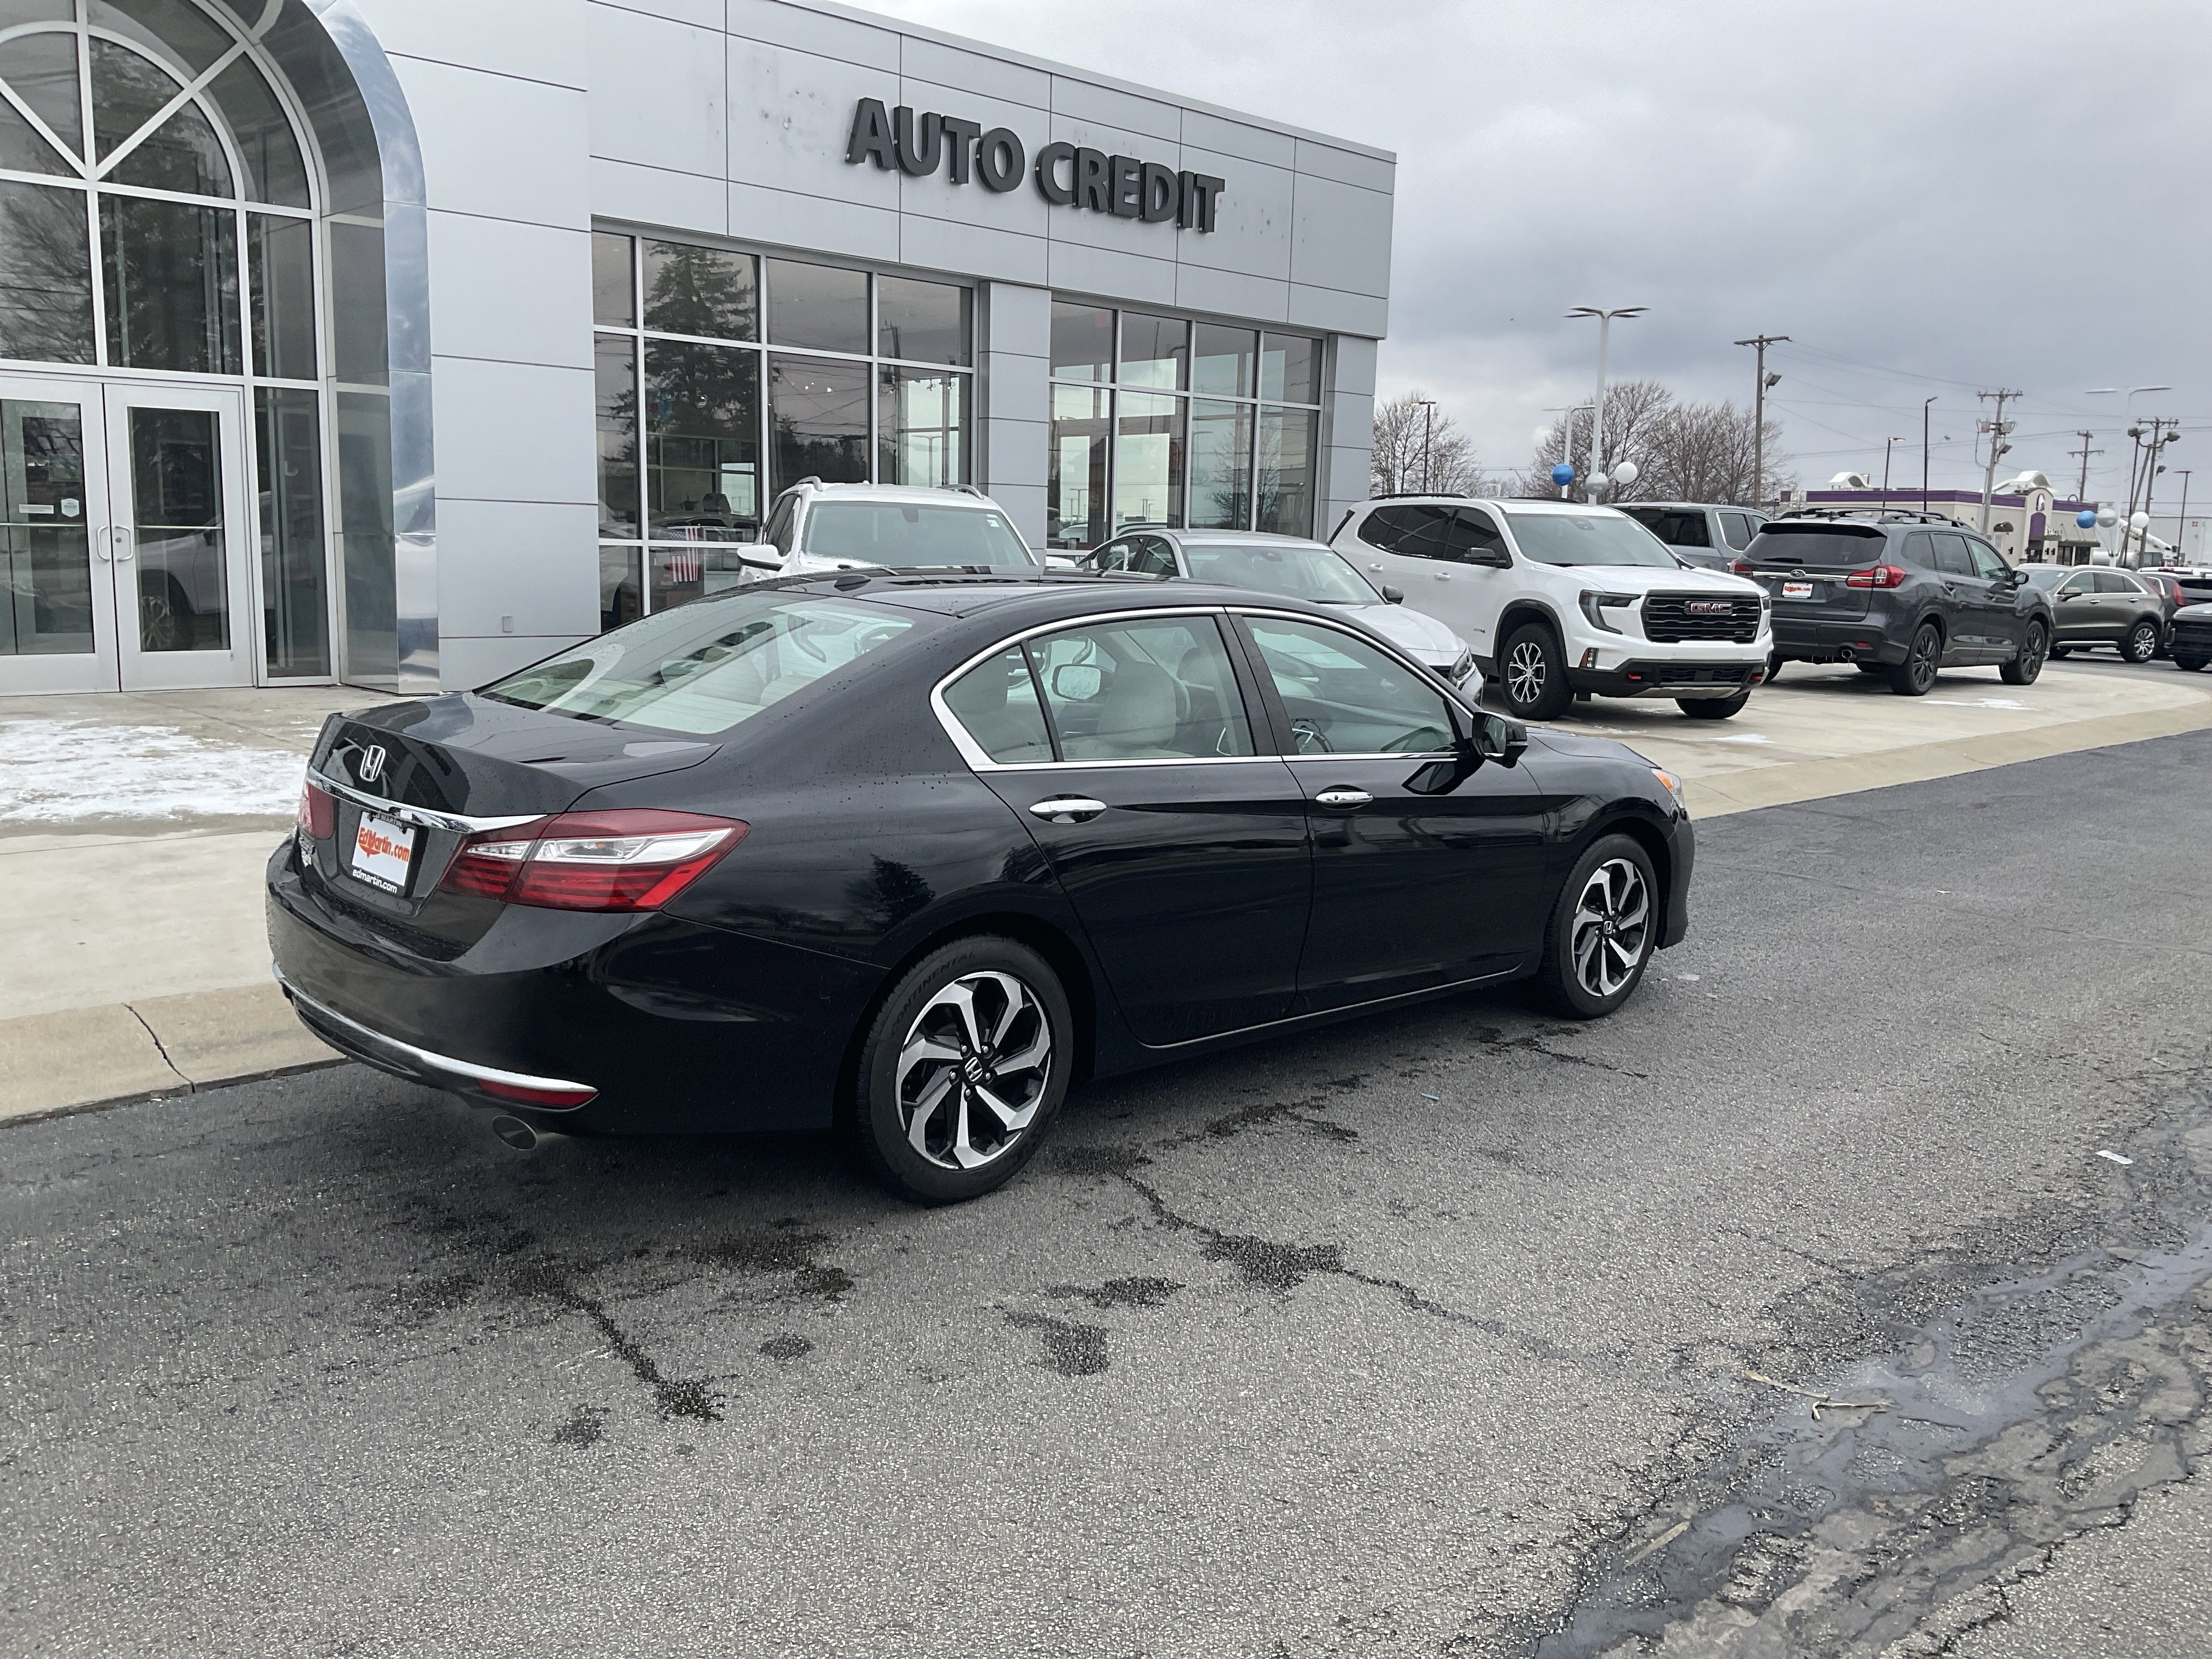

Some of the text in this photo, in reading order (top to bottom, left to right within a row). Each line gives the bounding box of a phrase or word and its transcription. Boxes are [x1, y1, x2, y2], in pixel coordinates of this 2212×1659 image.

[845, 97, 1225, 232] AUTO CREDIT
[1691, 603, 1731, 613] GMC
[358, 827, 410, 862] EdMartin.com
[353, 868, 397, 894] edmartin.com
[891, 950, 975, 1036] CONTINENTAL
